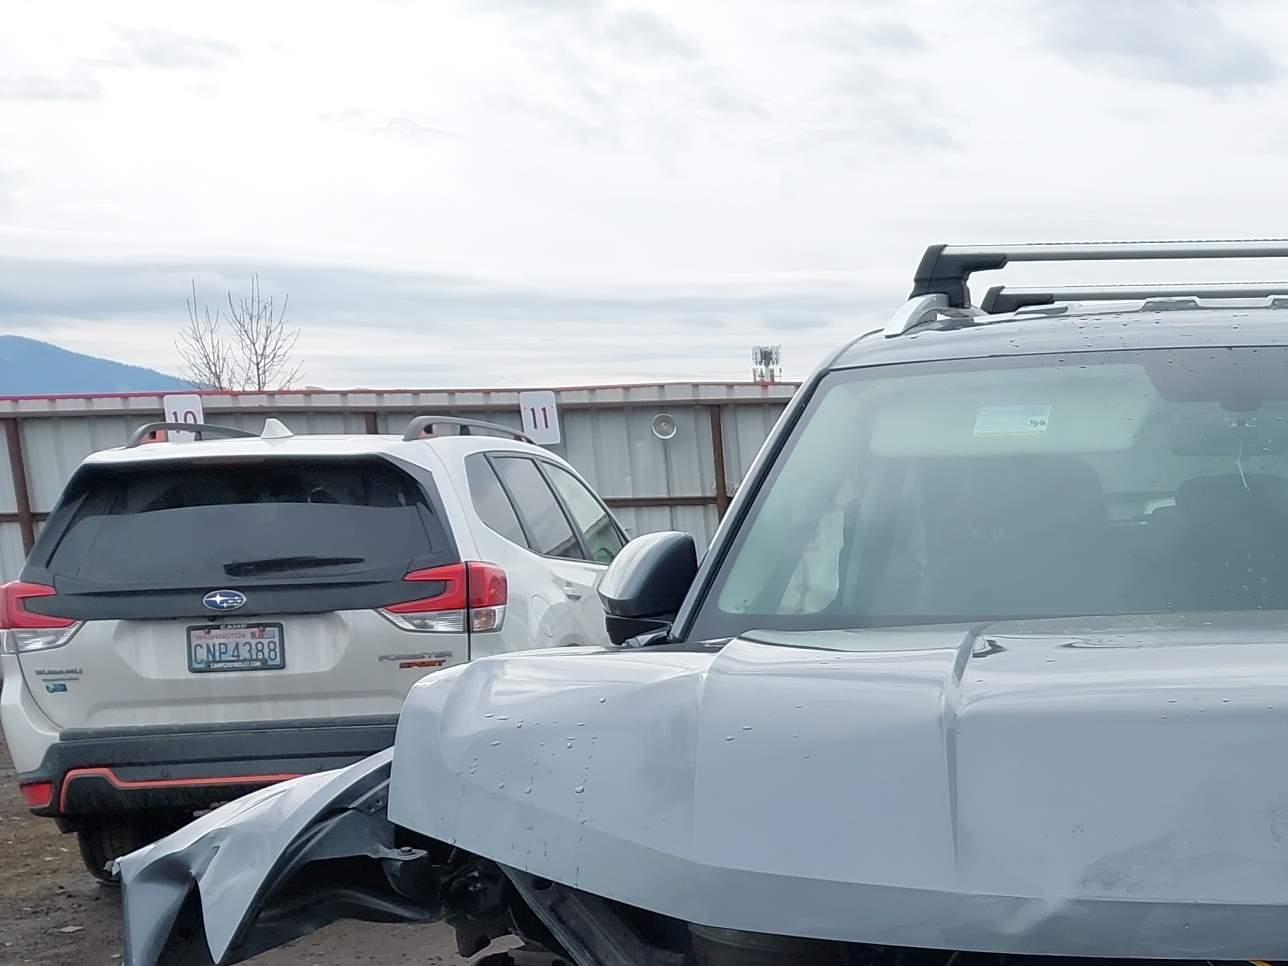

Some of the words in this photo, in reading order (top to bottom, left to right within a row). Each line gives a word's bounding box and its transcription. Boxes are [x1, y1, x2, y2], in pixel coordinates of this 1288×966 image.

[530, 406, 549, 430] 11
[193, 632, 246, 640] WASHINGTON
[194, 640, 278, 665] CNP4388
